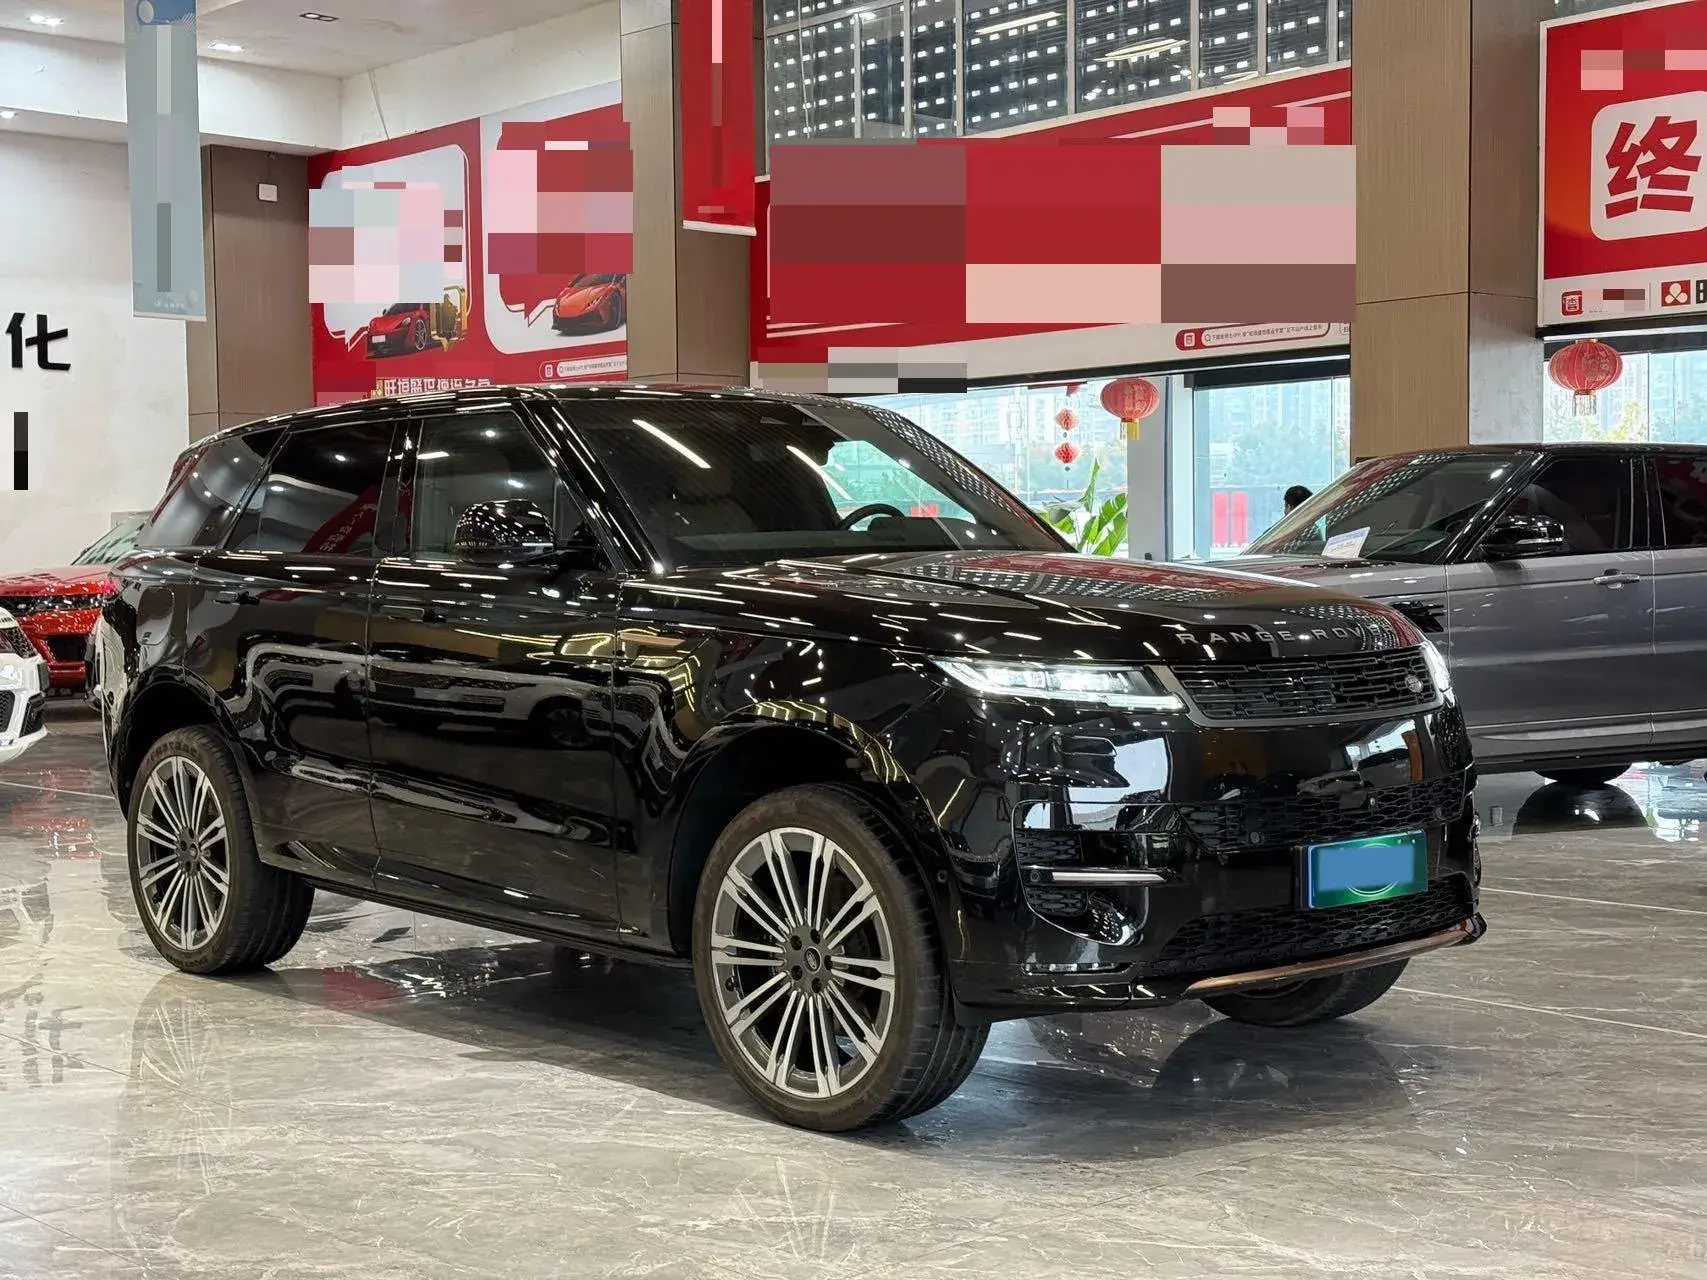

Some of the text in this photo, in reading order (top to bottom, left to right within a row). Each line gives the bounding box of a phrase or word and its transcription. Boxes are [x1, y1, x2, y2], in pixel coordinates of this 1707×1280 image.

[1605, 116, 1702, 219] 终
[5, 312, 71, 371] 化
[1175, 630, 1296, 645] RANGE
